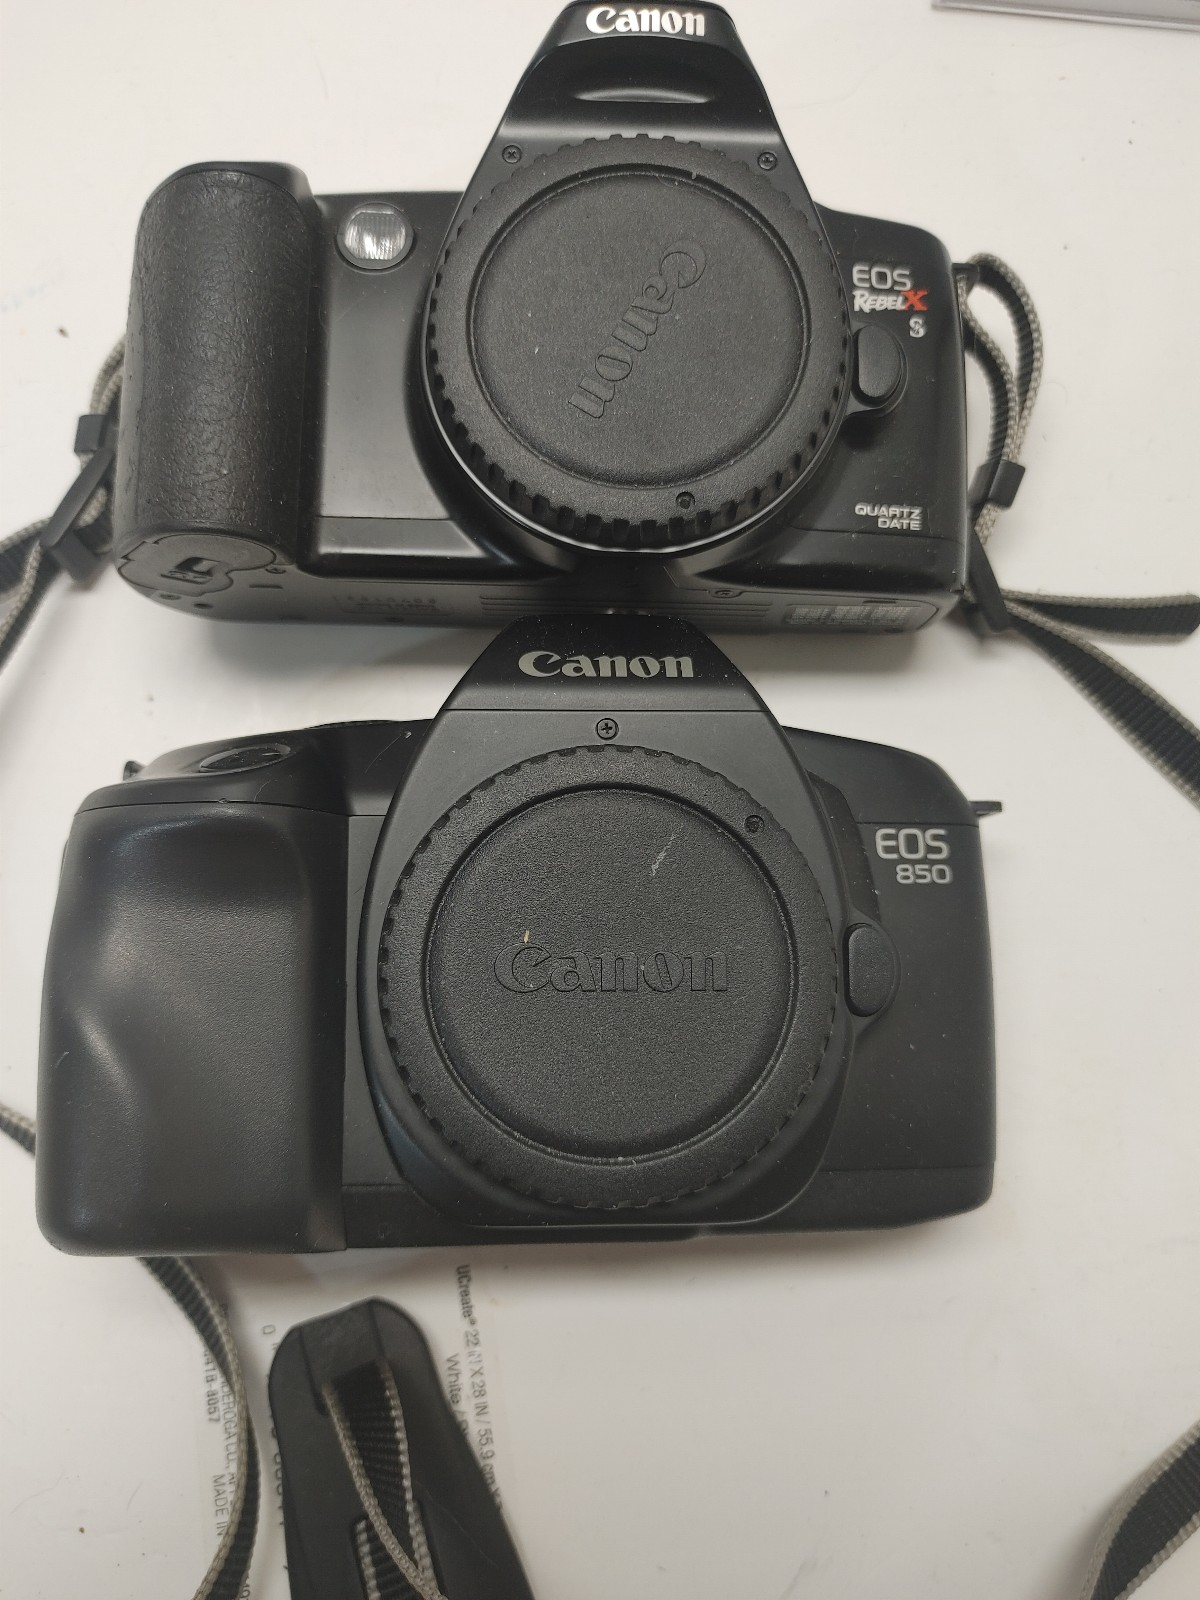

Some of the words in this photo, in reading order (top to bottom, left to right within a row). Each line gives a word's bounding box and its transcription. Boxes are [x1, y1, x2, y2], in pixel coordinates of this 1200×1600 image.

[585, 6, 705, 37] Canon
[852, 264, 912, 291] EOS
[567, 239, 707, 419] Canon
[854, 502, 923, 520] QUARTZ
[877, 517, 922, 532] DATE
[518, 650, 694, 678] Canon
[875, 828, 949, 860] EOS
[895, 864, 952, 884] 850
[494, 942, 729, 994] Canon
[465, 1329, 481, 1348] 22
[446, 1353, 463, 1404] White
[471, 1380, 487, 1399] 28
[473, 1401, 490, 1417] IN
[478, 1428, 496, 1461] 55.9
[213, 1474, 230, 1517] MADE
